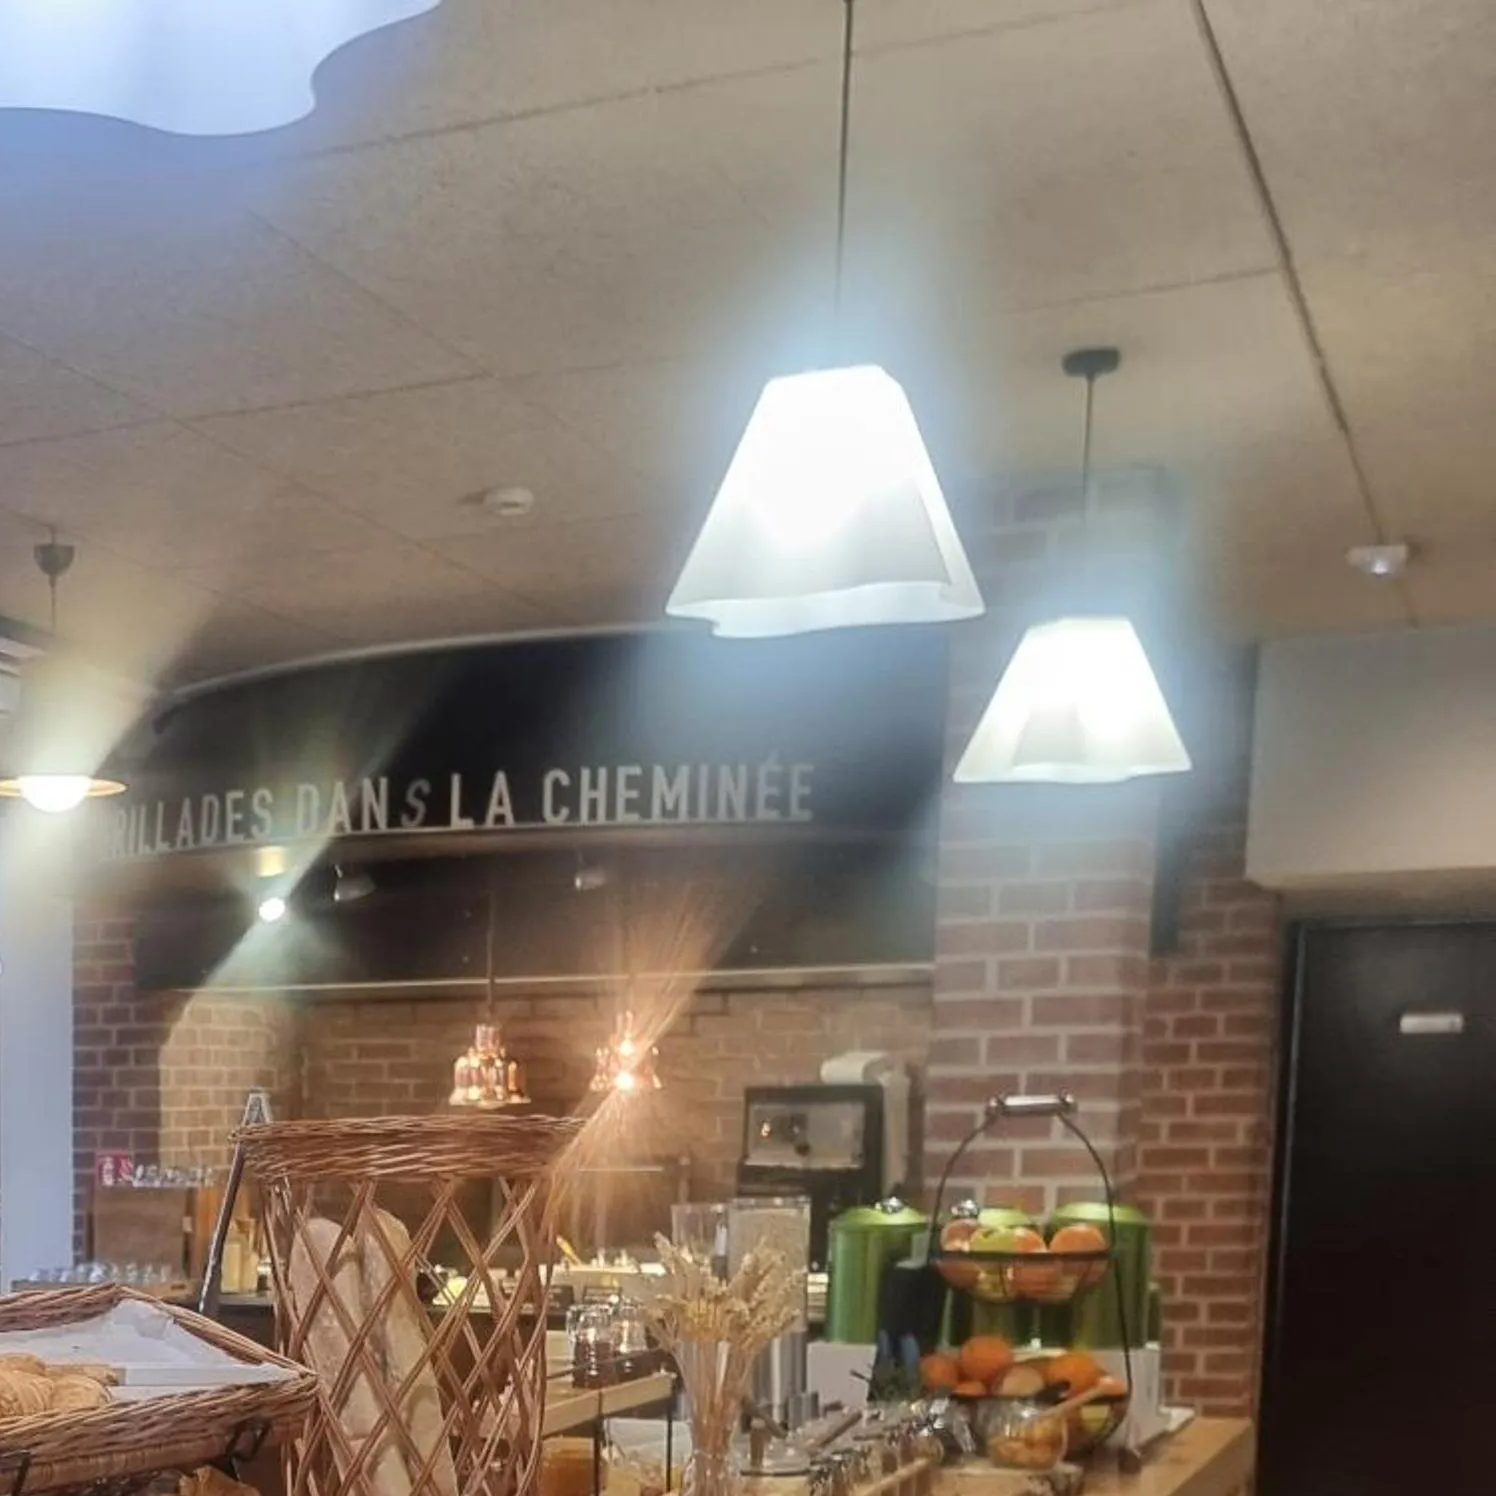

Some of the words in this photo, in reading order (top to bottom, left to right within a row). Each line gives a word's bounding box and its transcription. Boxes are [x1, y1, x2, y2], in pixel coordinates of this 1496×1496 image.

[107, 788, 274, 858] RILLADES
[449, 769, 516, 830] LA
[542, 751, 815, 826] CHEMINÉE
